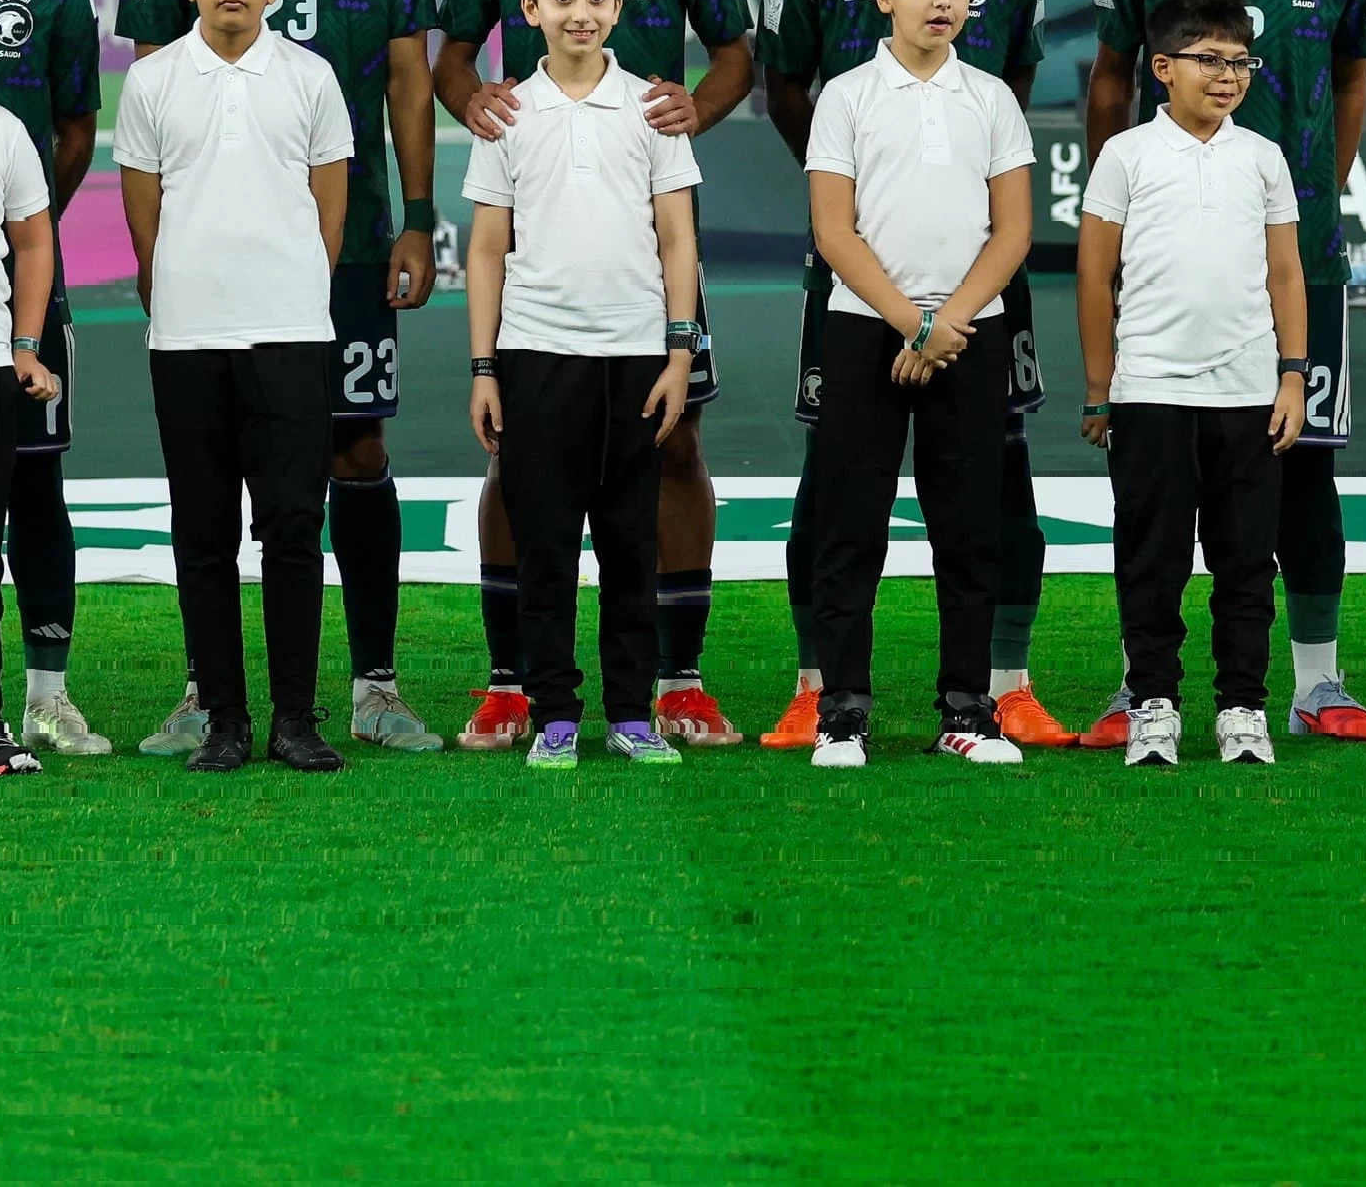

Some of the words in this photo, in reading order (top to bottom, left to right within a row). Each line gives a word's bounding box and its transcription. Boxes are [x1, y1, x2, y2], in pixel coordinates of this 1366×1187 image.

[1292, 0, 1315, 9] SAUDI
[1051, 141, 1081, 229] AFC
[343, 338, 397, 403] 23
